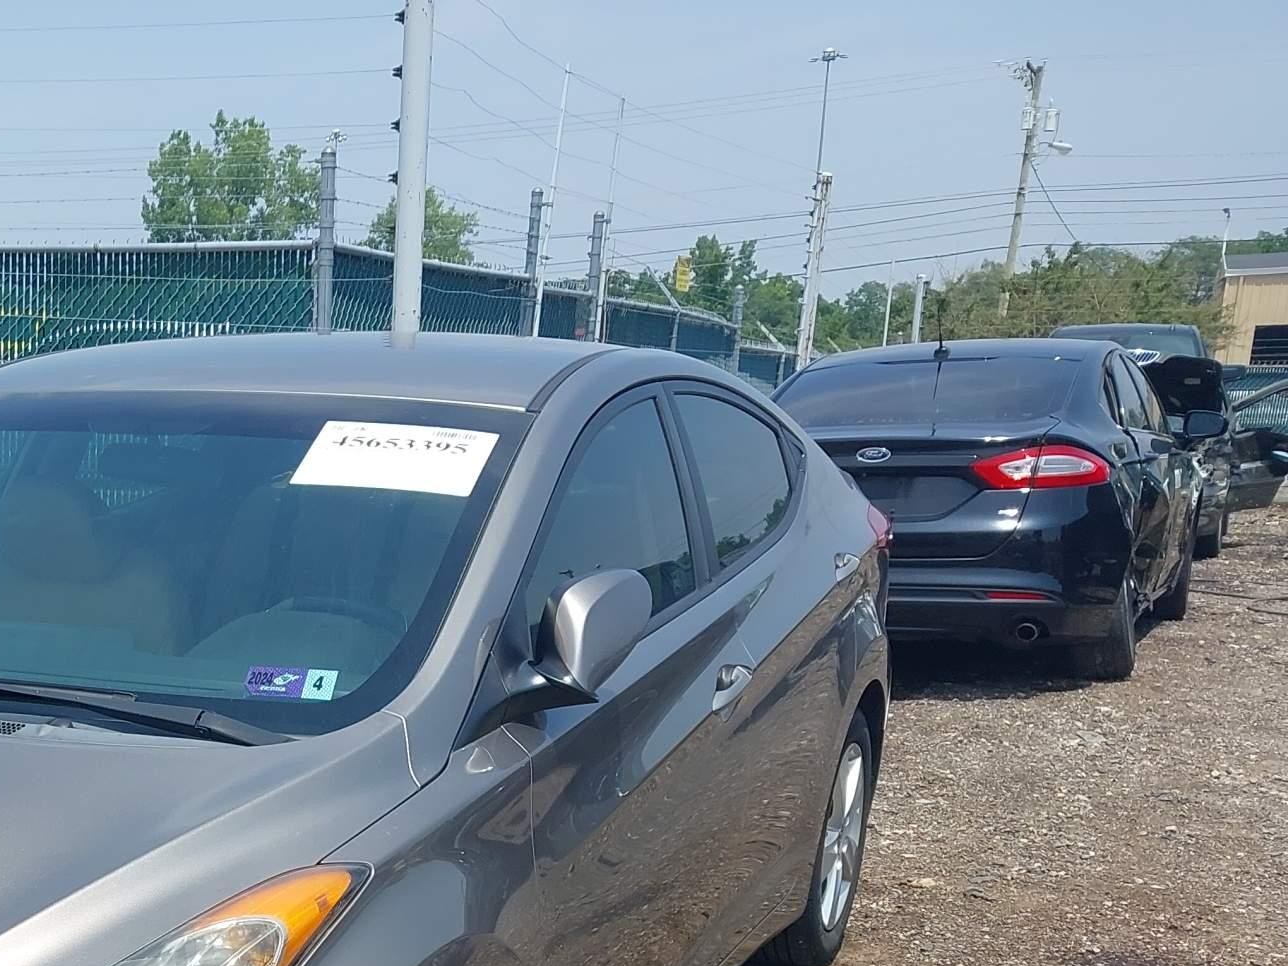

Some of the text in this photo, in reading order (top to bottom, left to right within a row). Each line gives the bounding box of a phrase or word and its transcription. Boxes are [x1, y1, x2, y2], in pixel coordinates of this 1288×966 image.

[332, 434, 470, 455] 45653395
[247, 671, 275, 686] 2024
[312, 675, 325, 691] 4
